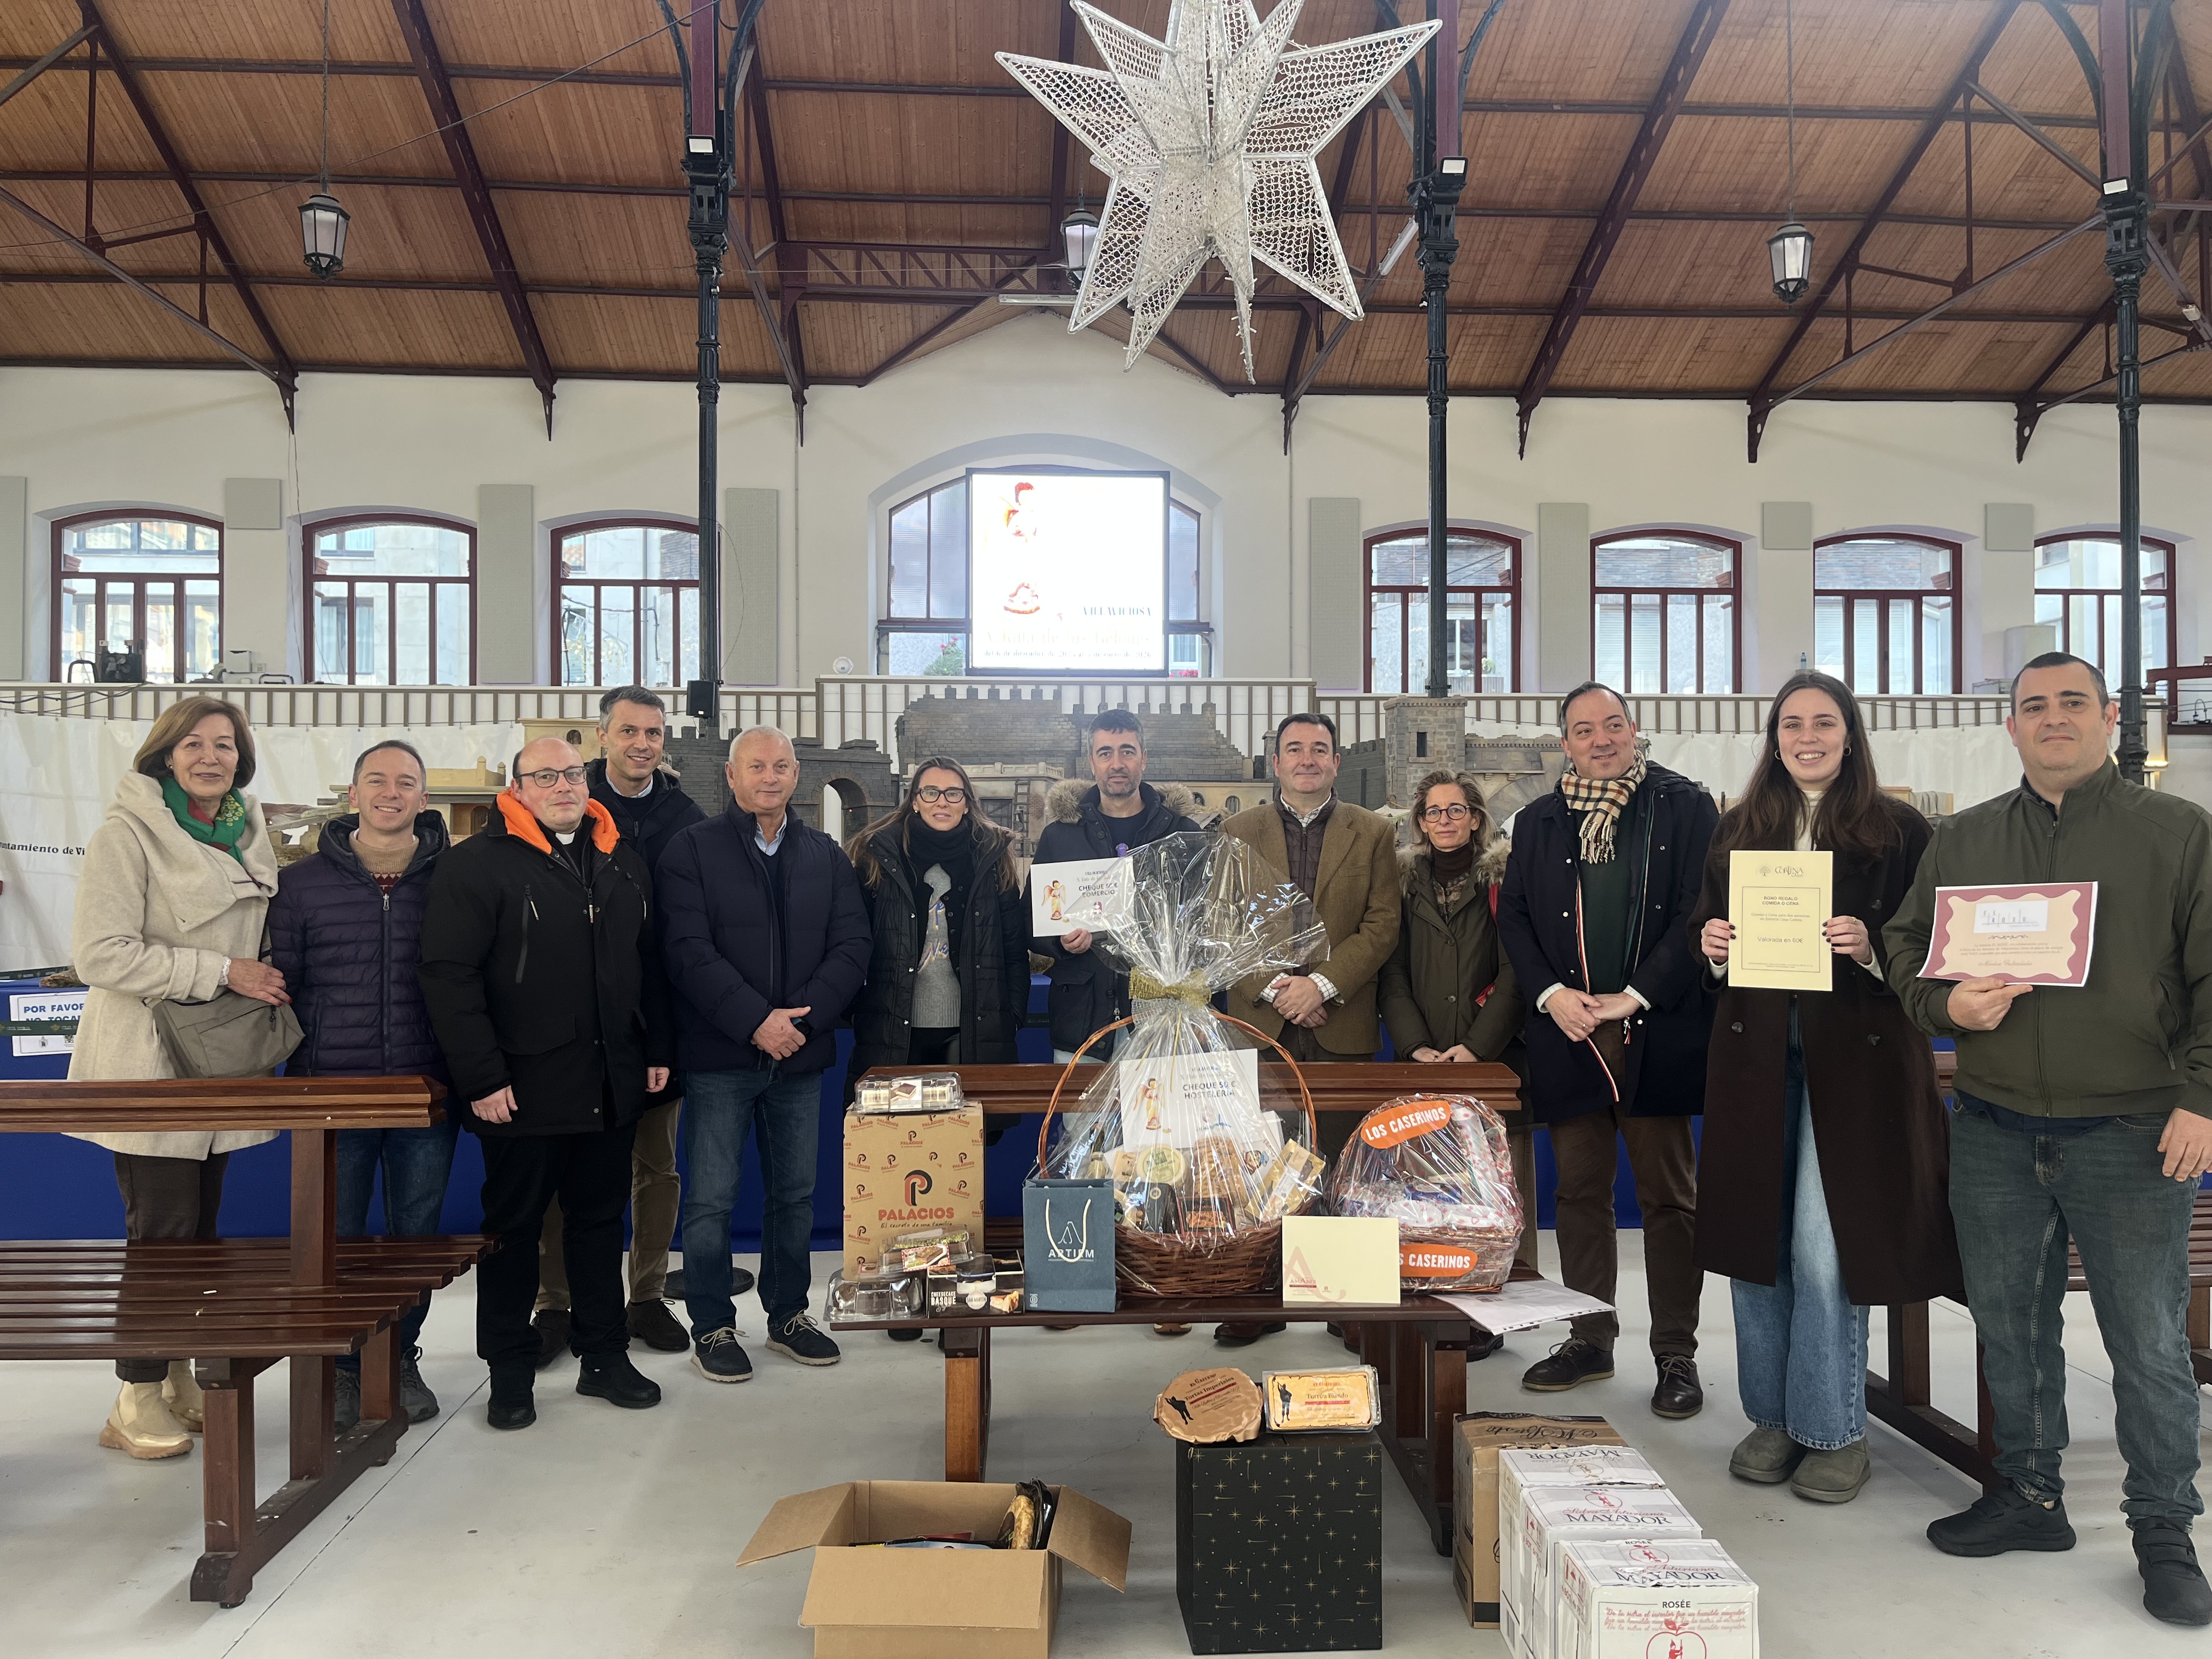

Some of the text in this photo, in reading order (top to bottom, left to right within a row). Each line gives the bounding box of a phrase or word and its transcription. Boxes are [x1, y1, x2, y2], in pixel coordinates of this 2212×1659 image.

[63, 847, 74, 855] de
[1082, 889, 1115, 898] COMERCIO
[24, 1005, 46, 1013] POR
[1365, 1107, 1446, 1141] LOS CASERINOS
[878, 1207, 955, 1221] PALACIOS
[1409, 1254, 1470, 1268] CASERINOS
[931, 1296, 956, 1306] BASQUE
[1184, 1390, 1204, 1401] Tortas
[1203, 1377, 1234, 1392] Imperiales
[1526, 1449, 1621, 1460] MAYADOR
[1565, 1513, 1672, 1525] MAYADOR
[1615, 1571, 1726, 1584] MAYADOR
[1662, 1600, 1691, 1609] ROSÉE
[1606, 1607, 1616, 1616] De
[1675, 1610, 1685, 1620] fue
